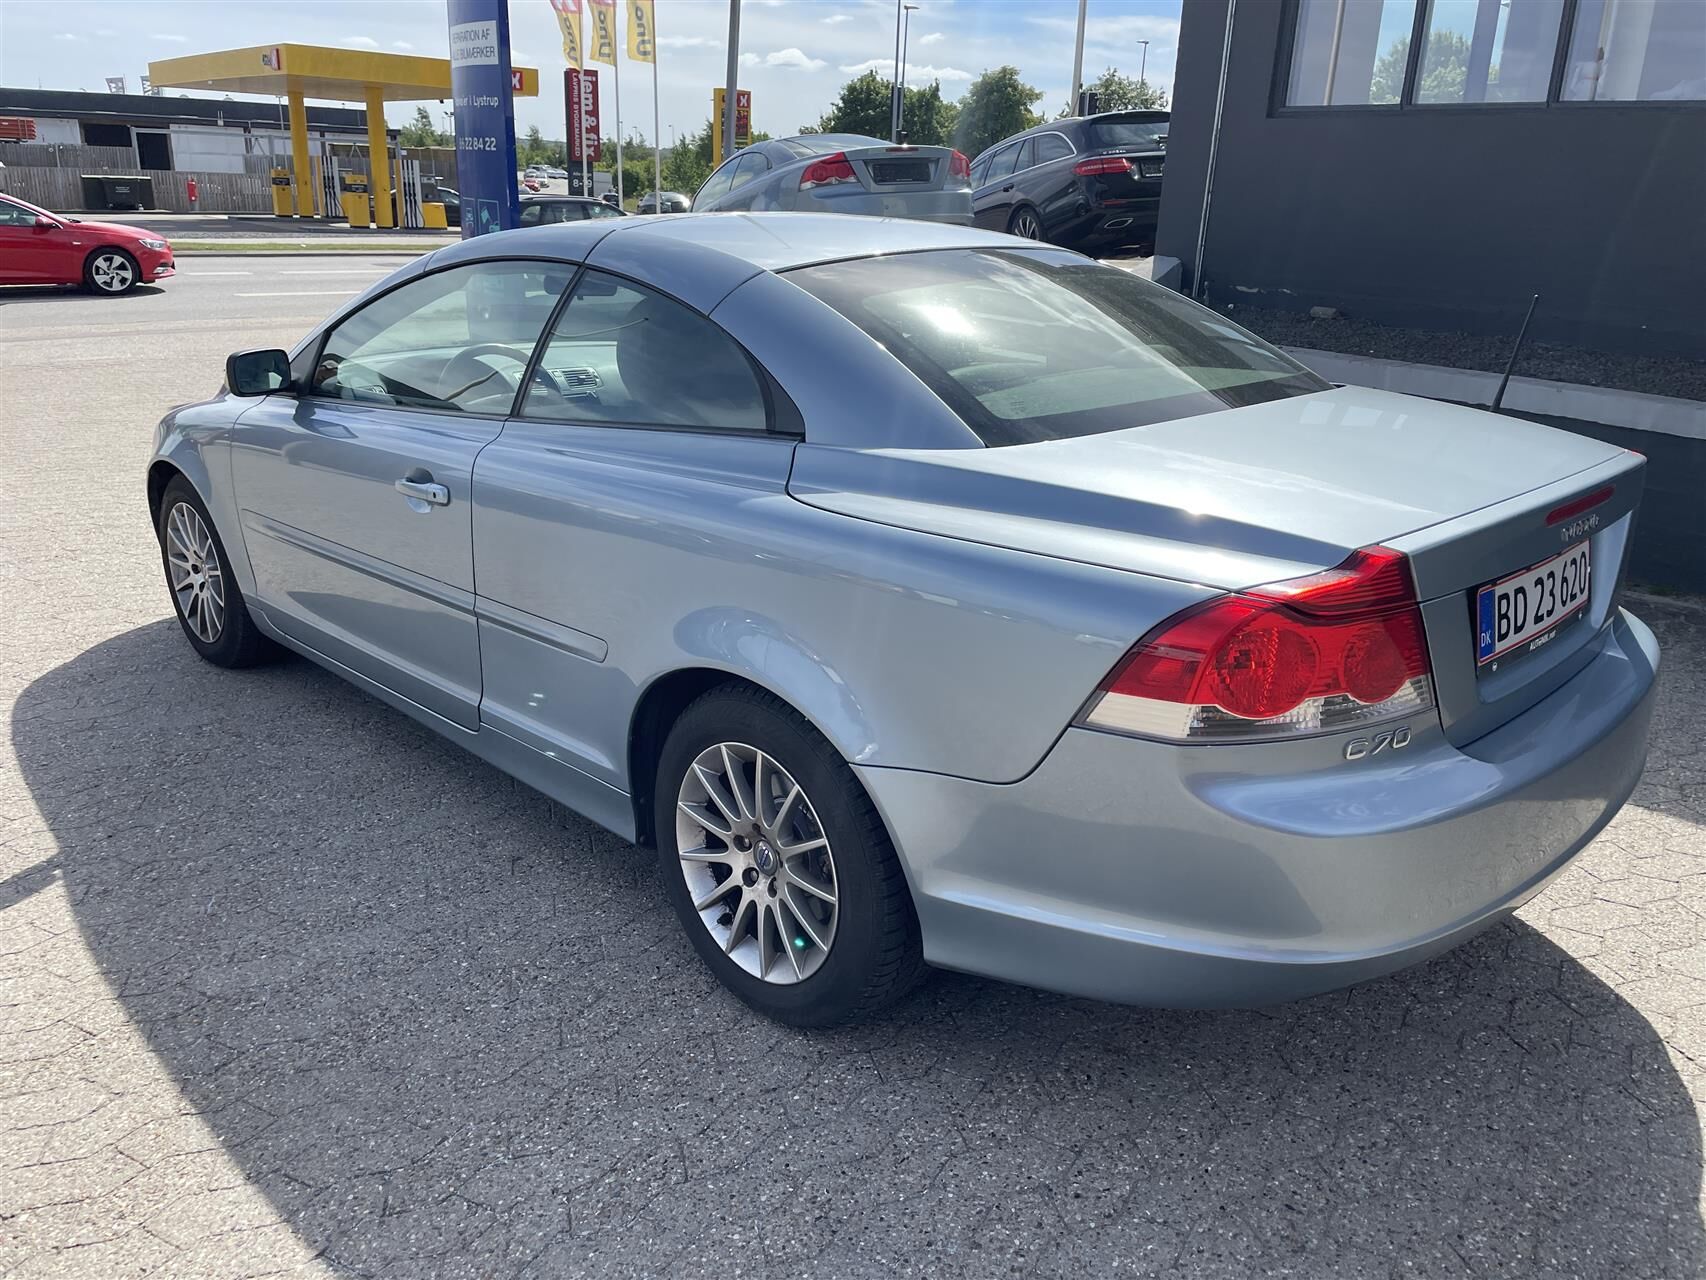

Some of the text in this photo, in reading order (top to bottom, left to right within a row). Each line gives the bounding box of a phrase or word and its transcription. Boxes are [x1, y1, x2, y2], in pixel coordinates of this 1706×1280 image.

[481, 28, 491, 41] AF
[473, 95, 500, 108] Lystrup
[1497, 550, 1588, 643] BD 23 620
[1480, 630, 1492, 648] DK
